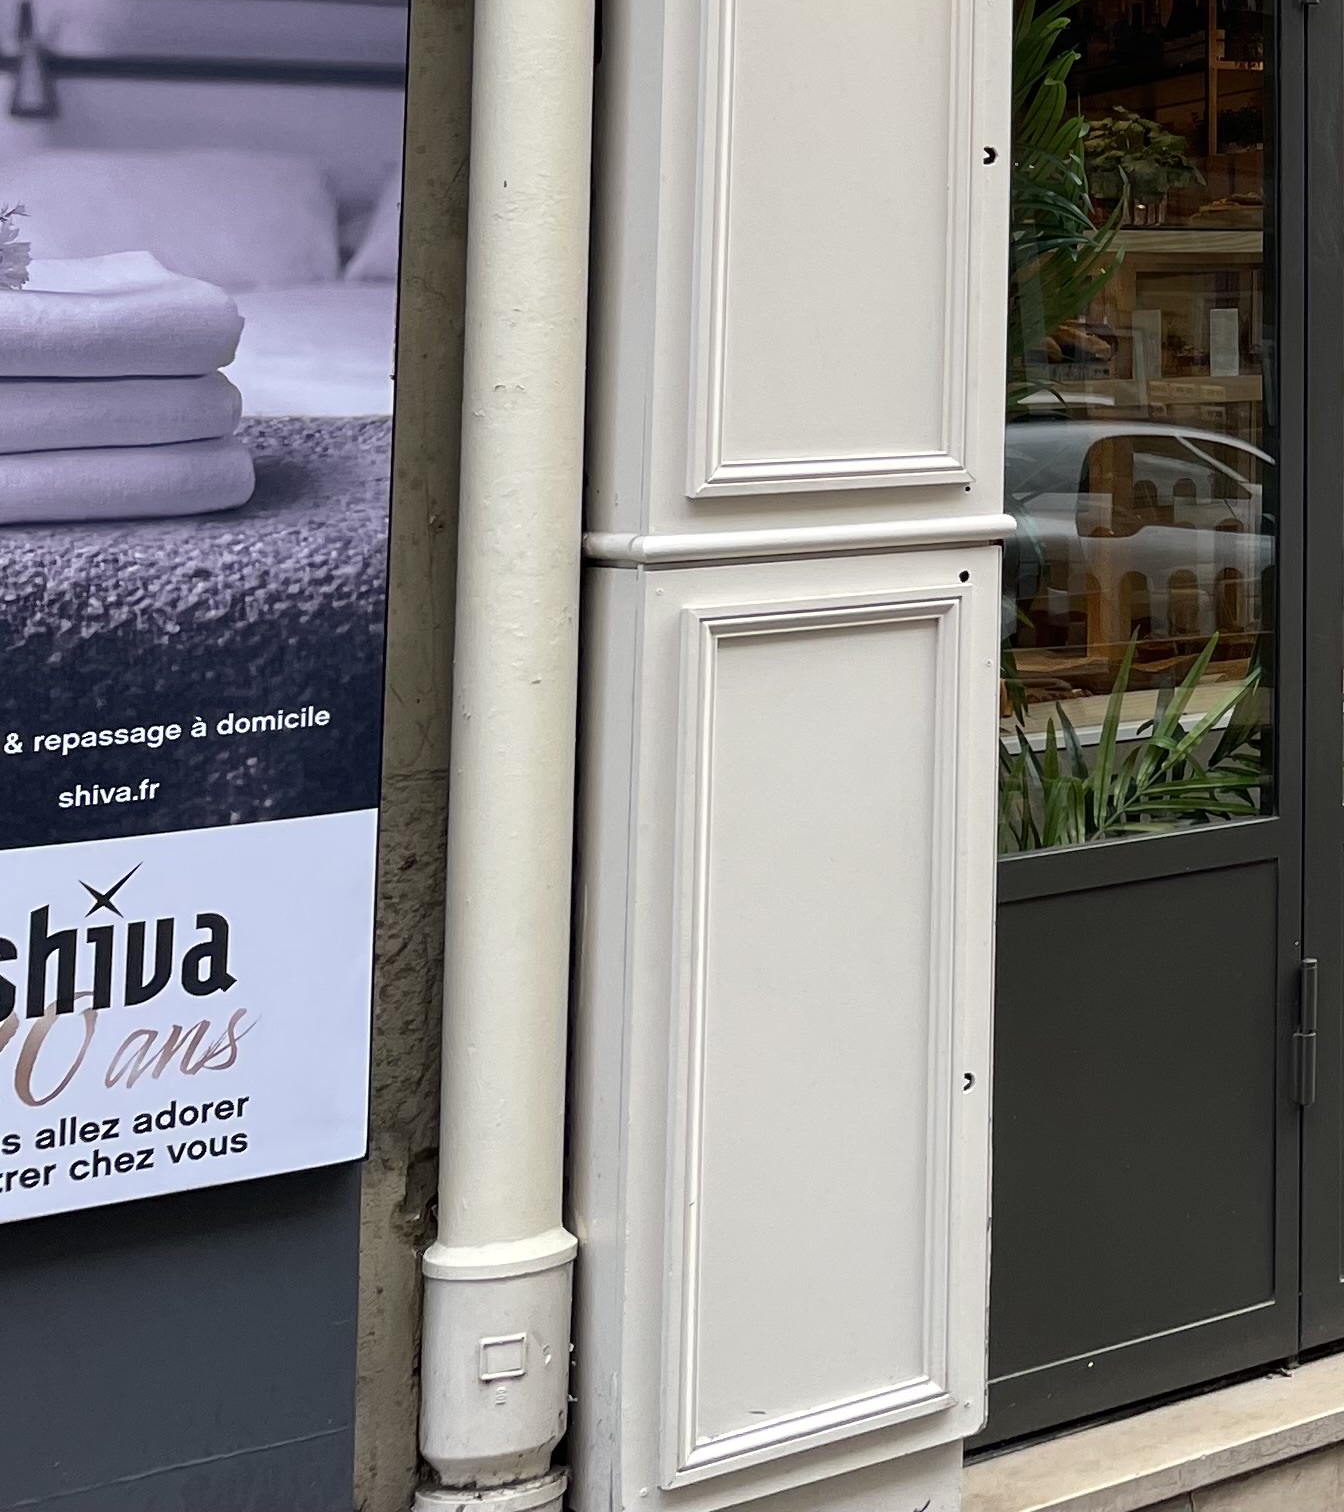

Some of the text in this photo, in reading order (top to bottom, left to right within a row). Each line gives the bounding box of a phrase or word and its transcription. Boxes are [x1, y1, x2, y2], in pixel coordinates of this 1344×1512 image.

[3, 706, 332, 756] & repassage à domicile
[58, 778, 161, 808] shiva.fr
[103, 1008, 260, 1089] ans
[35, 1116, 120, 1150] allez
[132, 1094, 250, 1135] adorer
[69, 1149, 154, 1181] chez
[168, 1132, 248, 1164] vous
